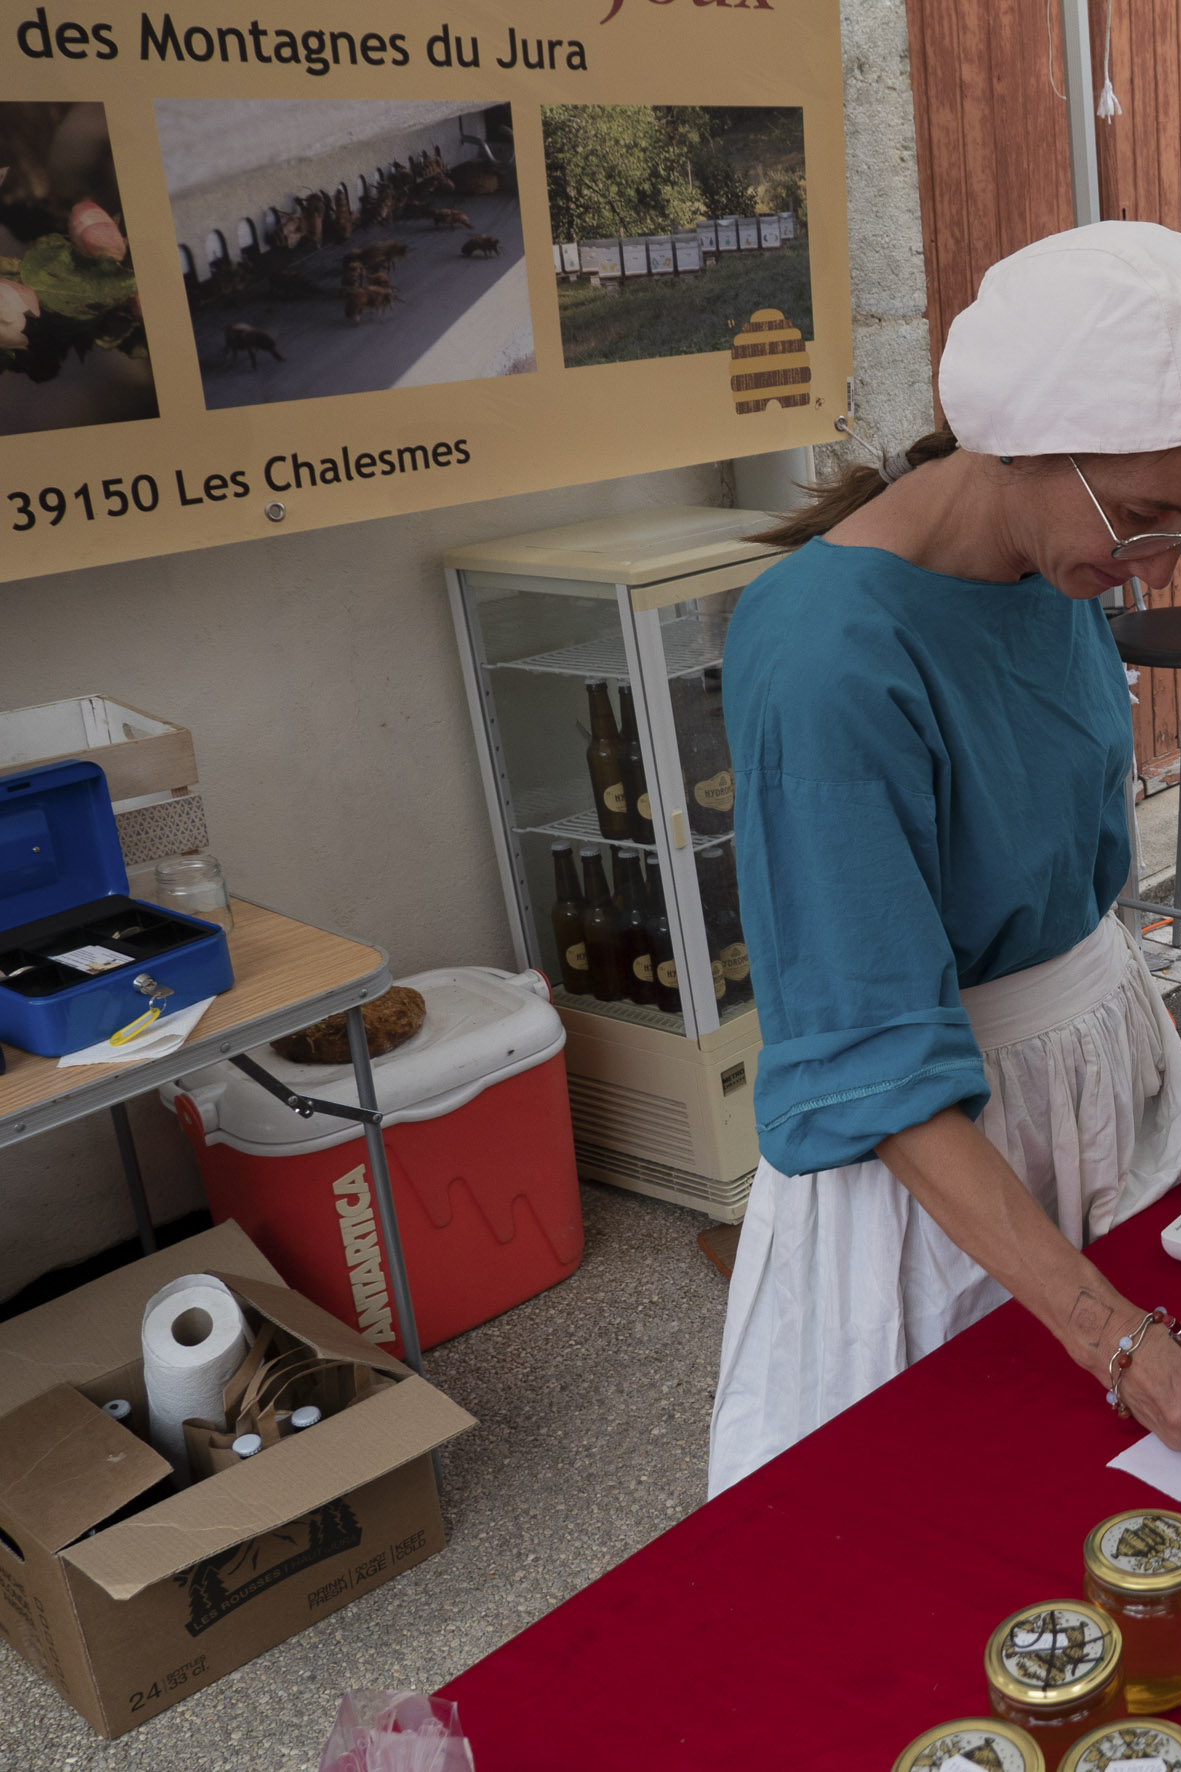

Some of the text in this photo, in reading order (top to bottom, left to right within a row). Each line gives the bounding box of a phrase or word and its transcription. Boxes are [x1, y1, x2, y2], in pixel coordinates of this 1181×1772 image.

[17, 7, 588, 75] des Montagnes du Jura
[7, 438, 471, 531] 39150 Les Chalesmes
[331, 1163, 396, 1345] ANTARTICA
[395, 1529, 425, 1551] KEEP
[396, 1539, 426, 1560] COLD
[356, 1561, 388, 1584] AGE
[369, 1551, 386, 1564] NOT
[193, 1609, 220, 1632] LES
[221, 1569, 281, 1611] ROUSSES
[307, 1575, 347, 1601] DRINK
[129, 1682, 162, 1712] 24
[168, 1673, 188, 1690] 33
